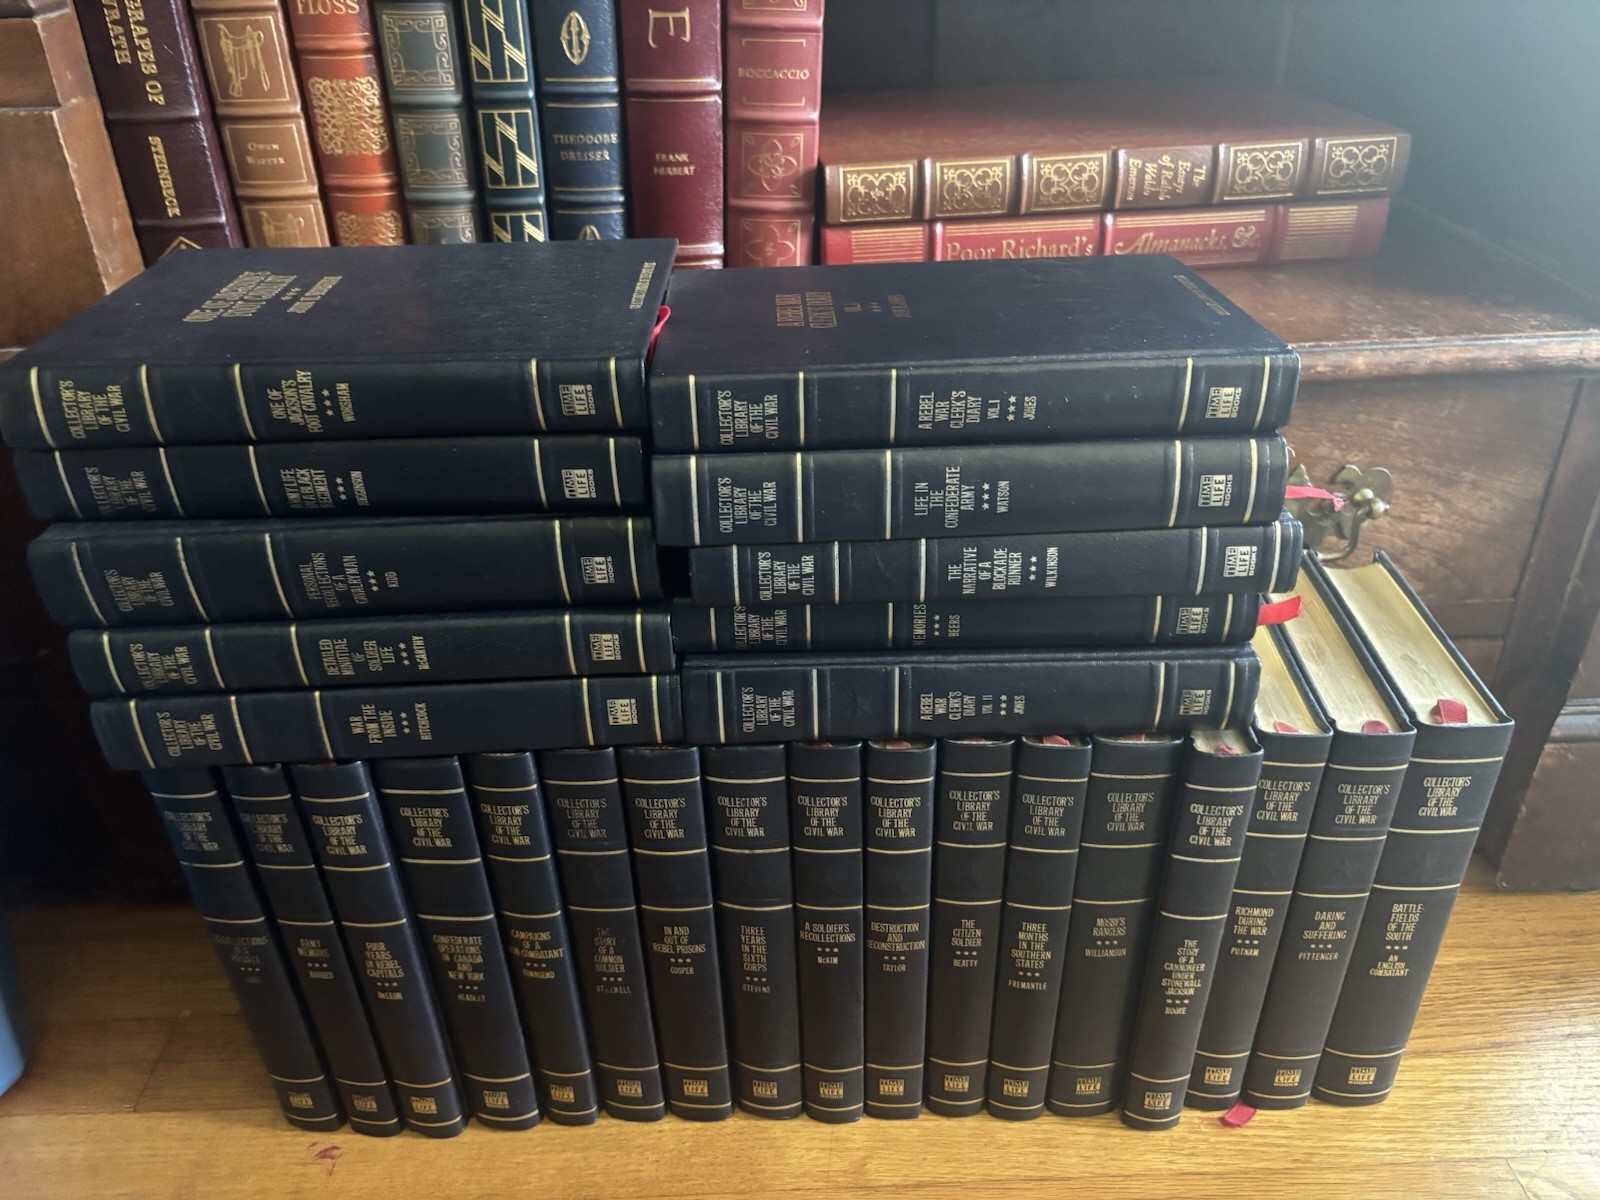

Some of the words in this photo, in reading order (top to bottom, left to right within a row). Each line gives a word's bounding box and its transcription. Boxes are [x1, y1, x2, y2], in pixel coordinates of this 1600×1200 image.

[297, 0, 360, 15] FLOSS
[737, 66, 811, 80] BOCCACCIO
[144, 80, 167, 106] OF
[552, 133, 619, 146] THEODORE
[559, 149, 611, 162] DREISER
[655, 152, 690, 162] FRANK
[1157, 154, 1175, 169] of
[147, 134, 182, 219] STEINBECK
[653, 165, 696, 177] HERBERT
[1126, 157, 1143, 201] Emerson
[1142, 162, 1158, 197] Waldo
[1172, 159, 1192, 194] Essays
[1192, 164, 1207, 187] The
[1155, 169, 1174, 201] Ralph
[946, 242, 996, 261] Poor
[1000, 235, 1094, 259] Richard's
[267, 388, 283, 400] OF
[296, 370, 317, 412] CAVALRY
[270, 402, 287, 419] ONE
[281, 380, 305, 425] JACKSON'S
[335, 383, 356, 422] WORSHAM
[764, 395, 778, 415] WAR
[918, 391, 934, 422] REBEL
[934, 401, 950, 421] WAR
[950, 390, 966, 429] CLERK'S
[966, 396, 982, 423] DIARY
[1023, 396, 1037, 420] JONES
[1207, 389, 1220, 416] TIME
[1220, 391, 1233, 416] LIFE
[1230, 387, 1242, 418] BOOKS
[717, 390, 733, 445] COLLECTOR'S
[733, 400, 749, 437] LIBRARY
[748, 403, 763, 422] THE
[304, 413, 324, 433] FOOT
[749, 423, 763, 433] OF
[764, 416, 778, 439] CIVIL
[280, 468, 298, 487] LIFE
[295, 468, 314, 493] BLACK
[310, 469, 334, 508] REGIMENT
[763, 481, 776, 502] WAR
[914, 482, 928, 492] IN
[1212, 479, 1224, 503] LIFE
[718, 477, 733, 533] COLLECTOR'S
[733, 486, 748, 524] LIBRARY
[748, 490, 762, 507] THE
[929, 490, 944, 509] THE
[944, 466, 961, 528] CONFEDERATE
[960, 485, 975, 510] ARMY
[996, 481, 1010, 513] WATSON
[748, 509, 762, 520] OF
[764, 503, 777, 526] CIVIL
[914, 496, 929, 516] LIFE
[992, 548, 1007, 590] BLOCKADE
[1008, 552, 1022, 585] RUNNER
[1045, 547, 1058, 587] WILKINSON
[1237, 549, 1250, 574] LIFE
[948, 564, 962, 580] THE
[962, 547, 977, 594] NARRATIVE
[978, 570, 991, 580] OF
[299, 561, 322, 600] PERSONAL
[311, 552, 340, 607] RECOLLECTIONS
[333, 581, 348, 591] OF
[342, 555, 369, 604] CAVALRYMAN
[384, 571, 400, 588] KIDD
[913, 604, 927, 646] MEMORIES
[948, 614, 960, 637] BEERS
[319, 639, 341, 676] DETAILED
[333, 638, 355, 676] MINUTIAE
[351, 652, 365, 662] OF
[363, 640, 383, 671] SOLDIER
[379, 646, 396, 663] LIFE
[920, 692, 933, 714] REBEL
[934, 698, 947, 715] WAR
[948, 691, 962, 720] CLERK'S
[963, 695, 976, 717] DIARY
[1013, 695, 1025, 715] JONES
[361, 704, 377, 721] THE
[348, 716, 365, 734] WAR
[379, 710, 398, 737] INSIDE
[414, 703, 432, 740] HITCHCOCK
[365, 723, 383, 743] FROM
[1235, 906, 1275, 917] RICHMOND
[1314, 911, 1346, 921] DARING
[1392, 904, 1424, 913] BATTLE
[961, 919, 975, 929] THE
[1096, 918, 1126, 927] MOSBY'S
[1238, 917, 1267, 926] DURING
[1318, 921, 1336, 930] AND
[1390, 913, 1420, 922] FIELDS
[663, 926, 672, 935] IN
[673, 927, 690, 936] AND
[740, 925, 764, 935] THREE
[805, 923, 811, 931] A
[812, 923, 850, 933] SOLDIER'S
[870, 922, 920, 933] DESTRUCTION
[952, 928, 981, 938] CITIZEN
[1021, 922, 1047, 932] THREE
[1092, 927, 1127, 936] RANGERS
[1233, 926, 1248, 935] THE
[1250, 926, 1268, 936] WAR
[1302, 930, 1347, 940] SUFFERING
[1387, 922, 1398, 931] OF
[1400, 922, 1416, 932] THE
[664, 936, 677, 945] OUT
[679, 936, 690, 945] OF
[740, 935, 766, 944] YEARS
[799, 930, 856, 943] RECOLLECTIONS
[887, 933, 905, 942] AND
[951, 937, 982, 947] SOLDIER
[1018, 931, 1048, 941] MONTHS
[1385, 931, 1412, 941] SOUTH
[653, 943, 675, 953] REBEL
[676, 944, 707, 954] PRISONS
[741, 944, 750, 954] IN
[752, 944, 767, 954] THE
[1010, 949, 1051, 960] SOUTHERN
[1018, 941, 1027, 950] IN
[1029, 941, 1044, 951] THE
[1084, 948, 1127, 957] WILLIAMSON
[1230, 947, 1259, 956] PUTNAM
[742, 954, 767, 963] SIXTH
[953, 958, 978, 967] BEATTY
[1014, 959, 1044, 969] STATES
[1298, 952, 1338, 961] PITTENGER
[1377, 961, 1406, 969] ENGLISH
[670, 966, 695, 975] COOPER
[743, 963, 768, 972] CORPS
[882, 963, 907, 972] TAYLOR
[1369, 968, 1409, 976] COMBATANT
[742, 984, 771, 993] STEVENS
[1008, 980, 1047, 990] FREMANTLE
